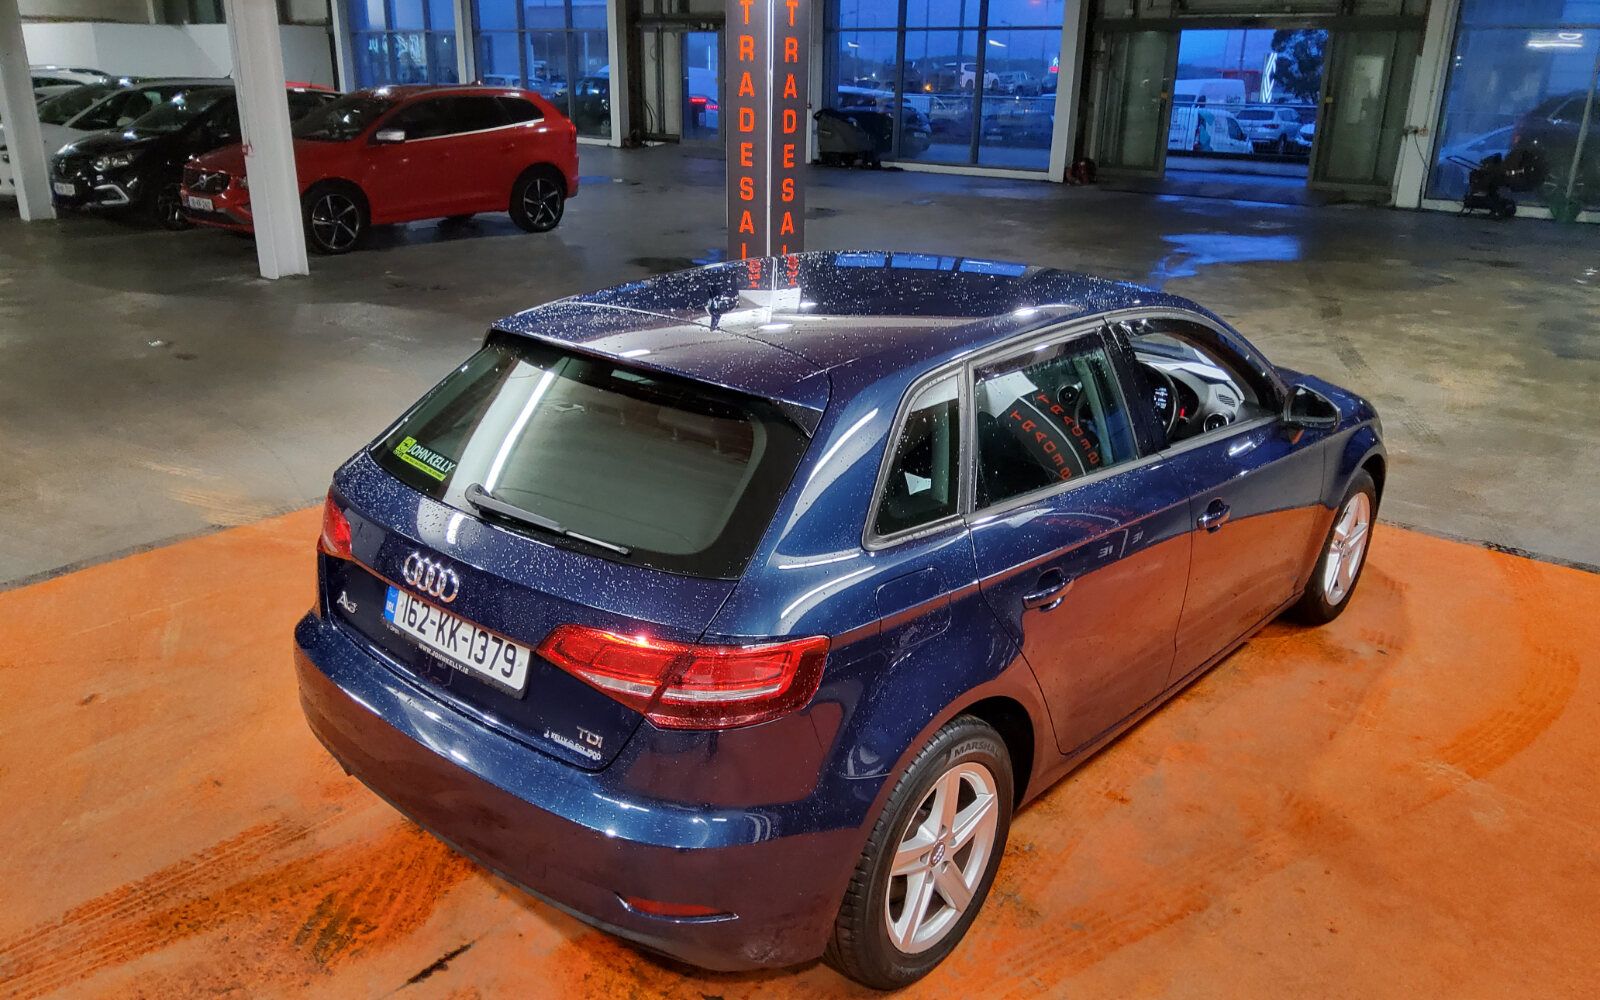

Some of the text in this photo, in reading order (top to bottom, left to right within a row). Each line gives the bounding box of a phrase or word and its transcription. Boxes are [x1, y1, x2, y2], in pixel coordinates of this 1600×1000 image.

[407, 443, 432, 462] JOHN
[427, 452, 456, 473] KELLY
[402, 595, 518, 679] 162-KK-1379
[577, 725, 603, 749] TDI
[953, 741, 999, 757] MARSHAL
